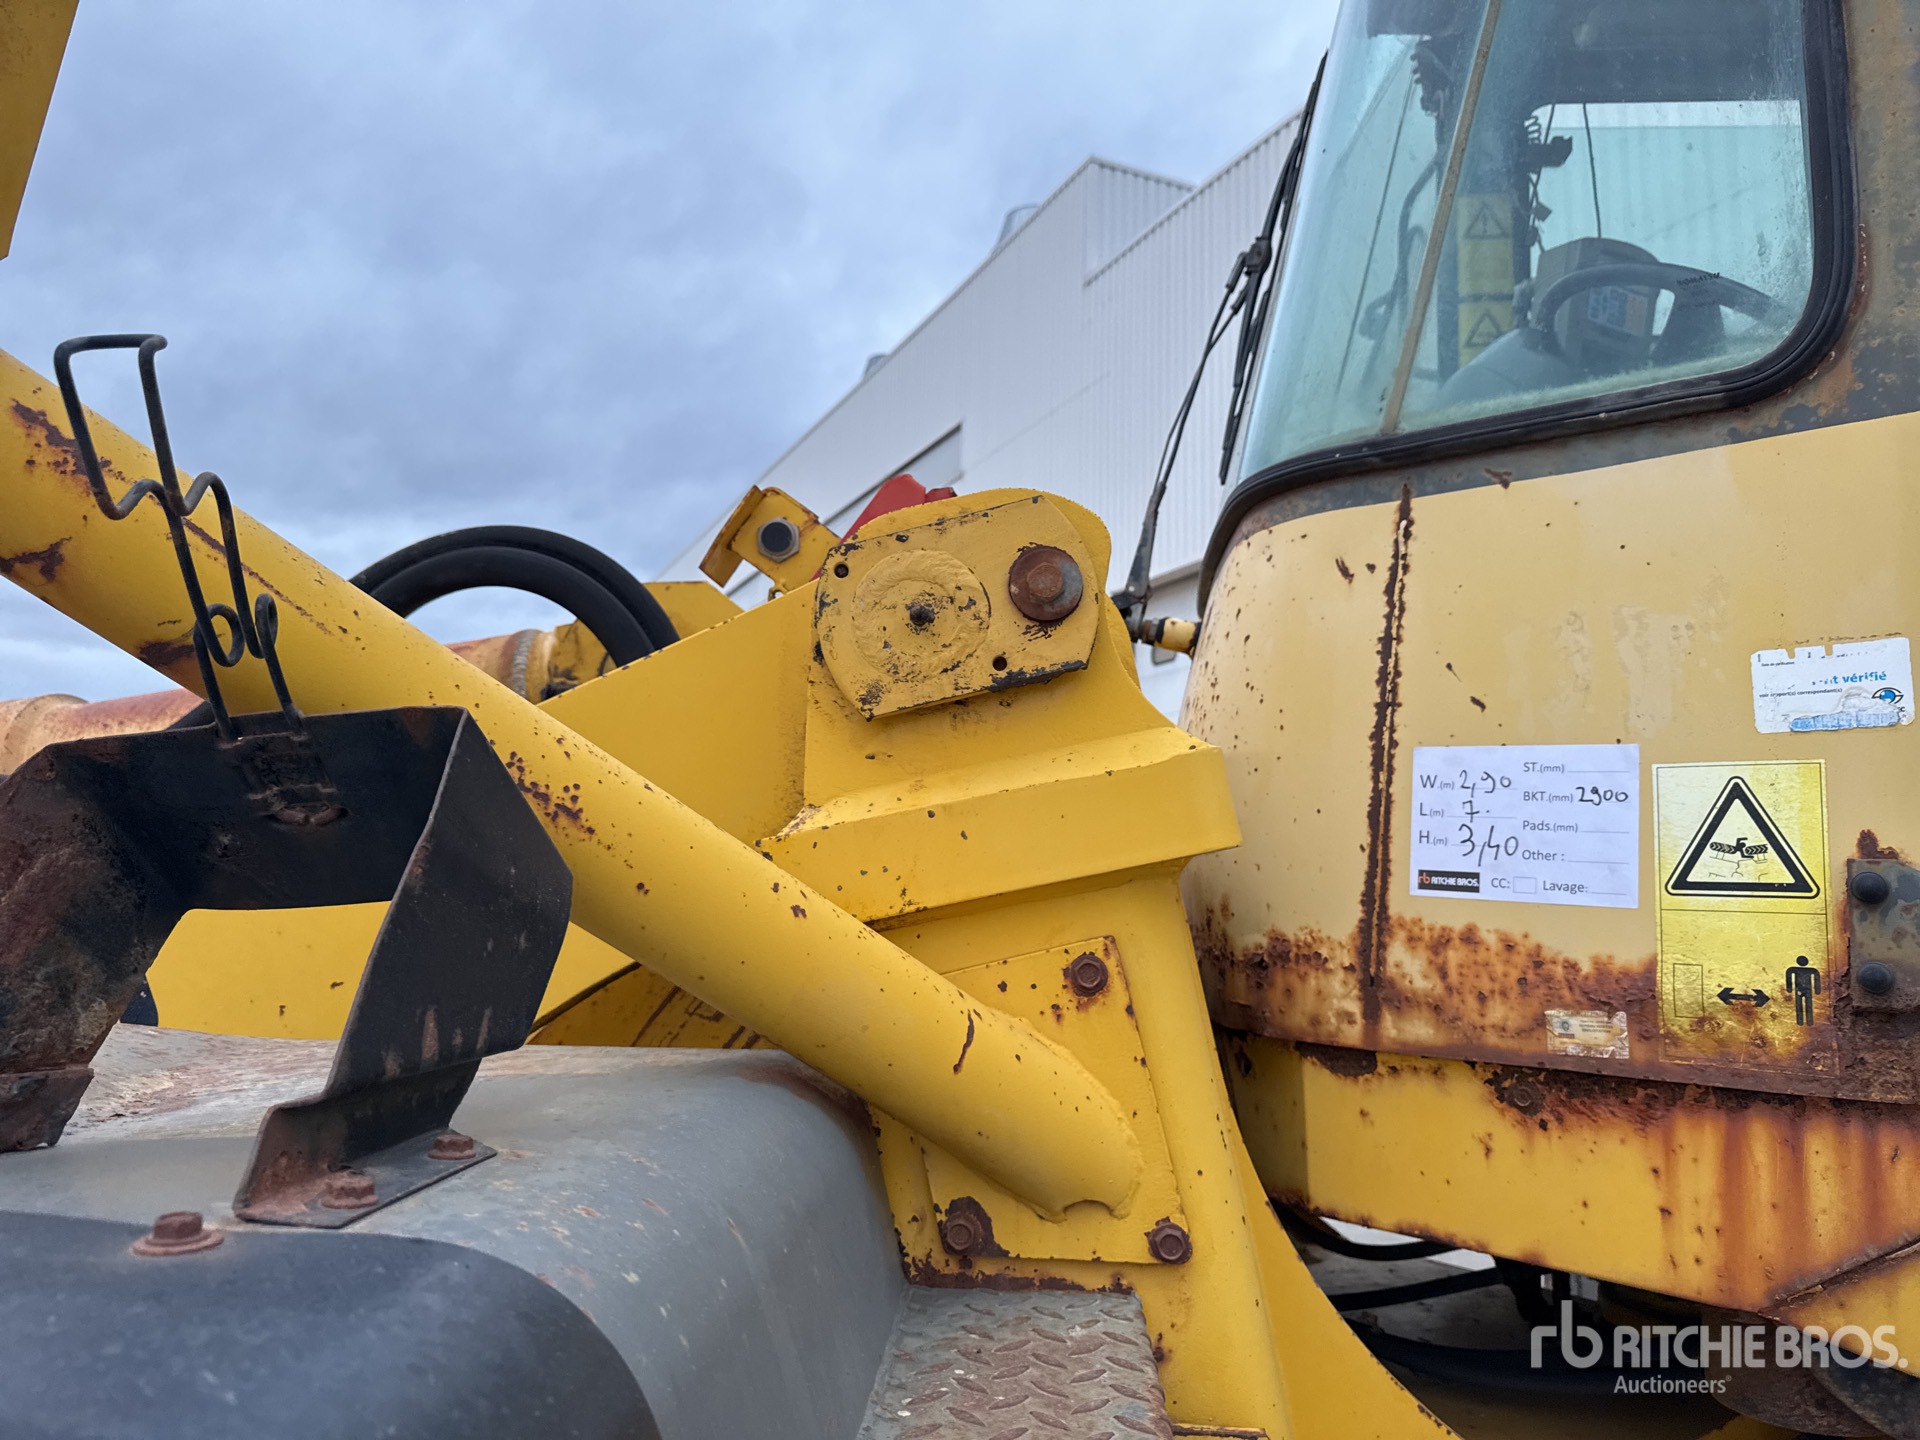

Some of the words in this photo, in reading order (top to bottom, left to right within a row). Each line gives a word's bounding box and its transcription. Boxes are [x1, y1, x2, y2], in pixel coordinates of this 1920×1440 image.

[1523, 791, 1573, 803] BKT.(mm)
[1522, 820, 1578, 833] Pads.(mm)
[1431, 876, 1456, 886] RITCHIE
[1491, 878, 1511, 889] CC:
[1542, 881, 1588, 893] Lavage:
